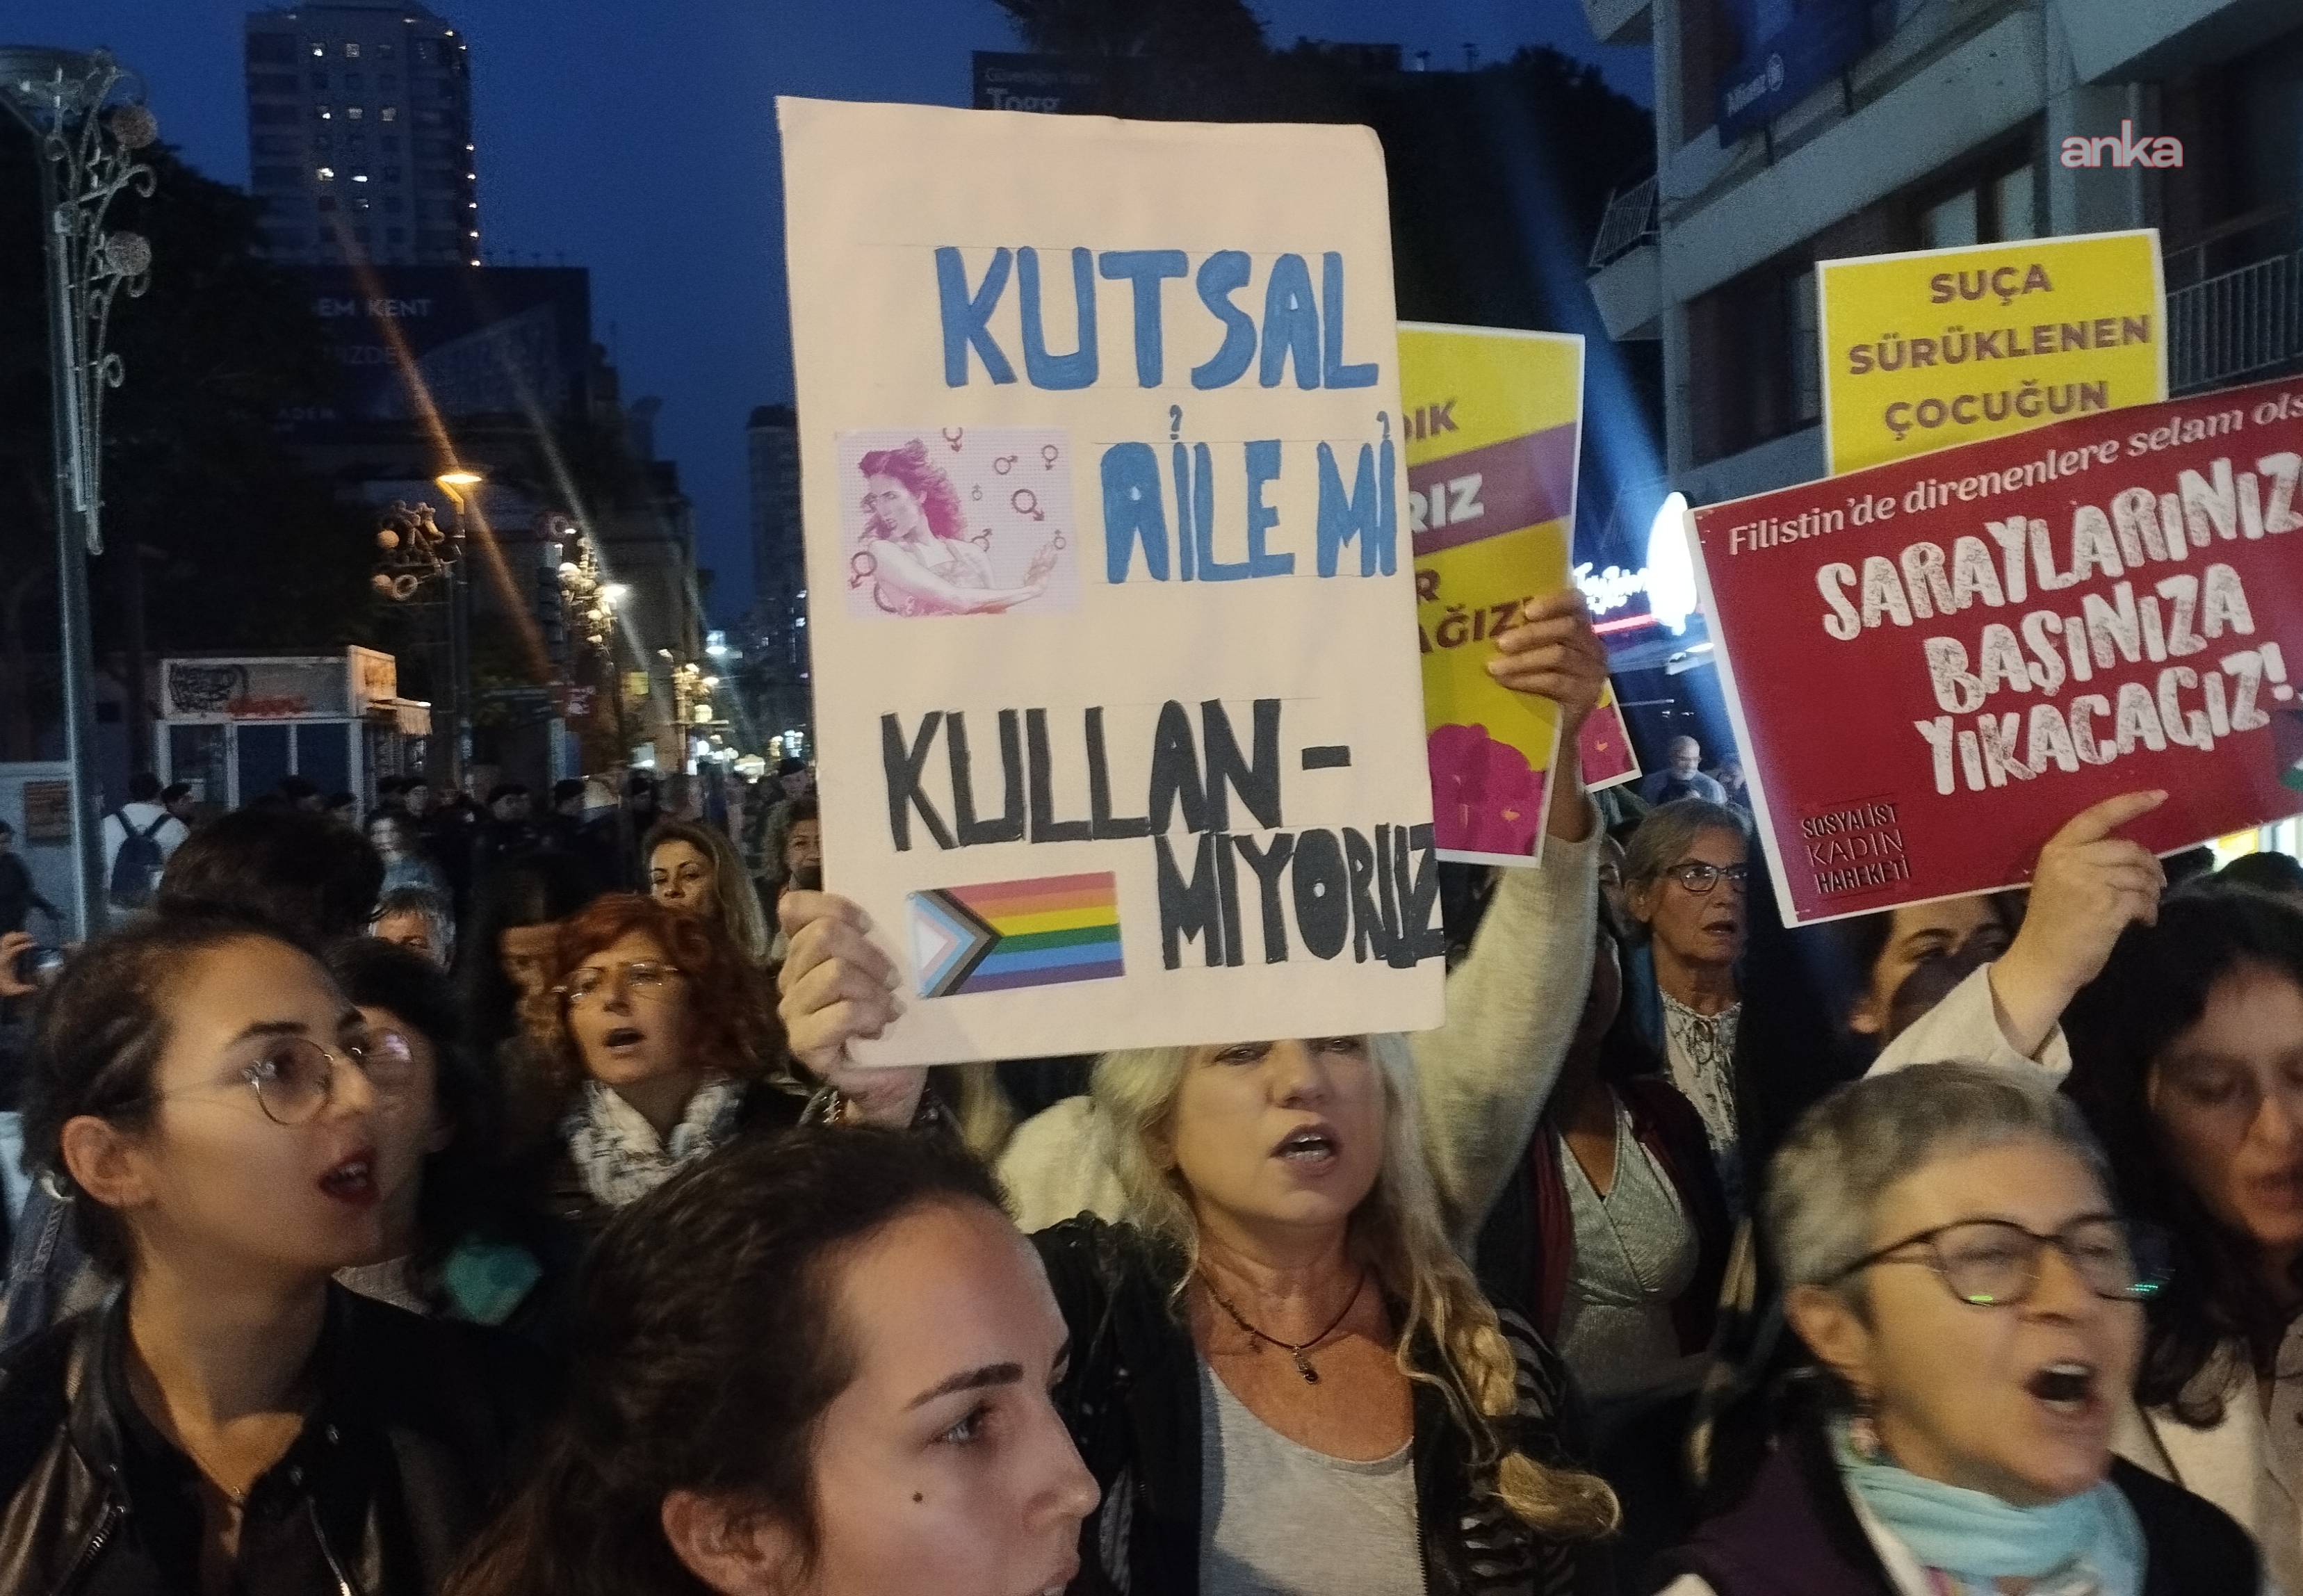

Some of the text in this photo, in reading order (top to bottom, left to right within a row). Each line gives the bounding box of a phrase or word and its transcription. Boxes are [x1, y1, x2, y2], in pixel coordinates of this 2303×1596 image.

[1928, 263, 2053, 306] SUÇA
[935, 246, 1379, 391] KUTSAL
[1848, 314, 2151, 375] SÜRÜKLENEN
[1884, 378, 2109, 441] ÇOCUĞUN
[1903, 439, 2120, 513] direnenlere
[2127, 409, 2245, 457] selam
[1924, 563, 2256, 714] BAŞINIZA
[1801, 802, 1896, 840] SOSYALİST
[1807, 829, 1903, 868] KADIN
[1154, 822, 1447, 970] MIYORUZ
[1814, 854, 1910, 895] HAREKETİ
